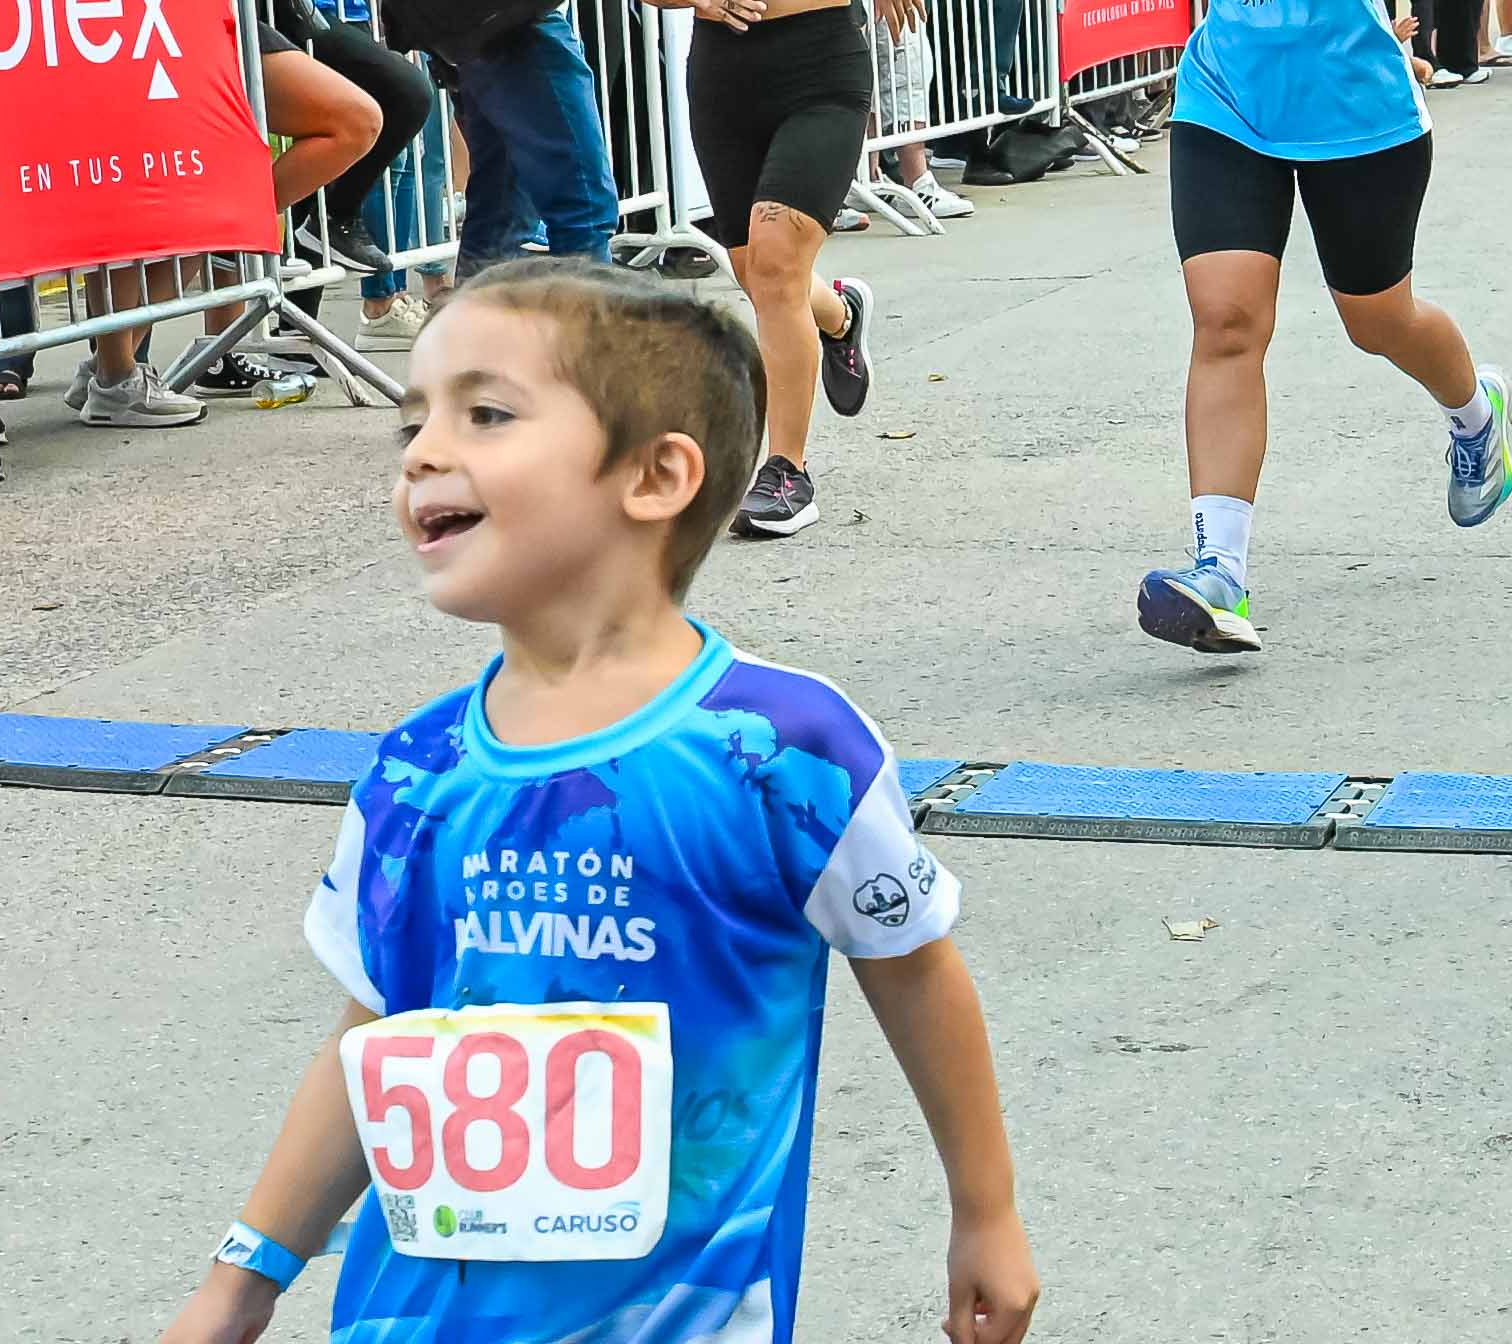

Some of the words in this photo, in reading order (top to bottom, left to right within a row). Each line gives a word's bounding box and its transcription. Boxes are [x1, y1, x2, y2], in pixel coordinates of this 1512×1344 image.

[20, 163, 51, 193] EN
[70, 155, 123, 187] TUS
[143, 149, 204, 178] PIES
[587, 885, 631, 906] DE
[361, 1029, 642, 1192] 580
[534, 1214, 638, 1234] CARUSO
